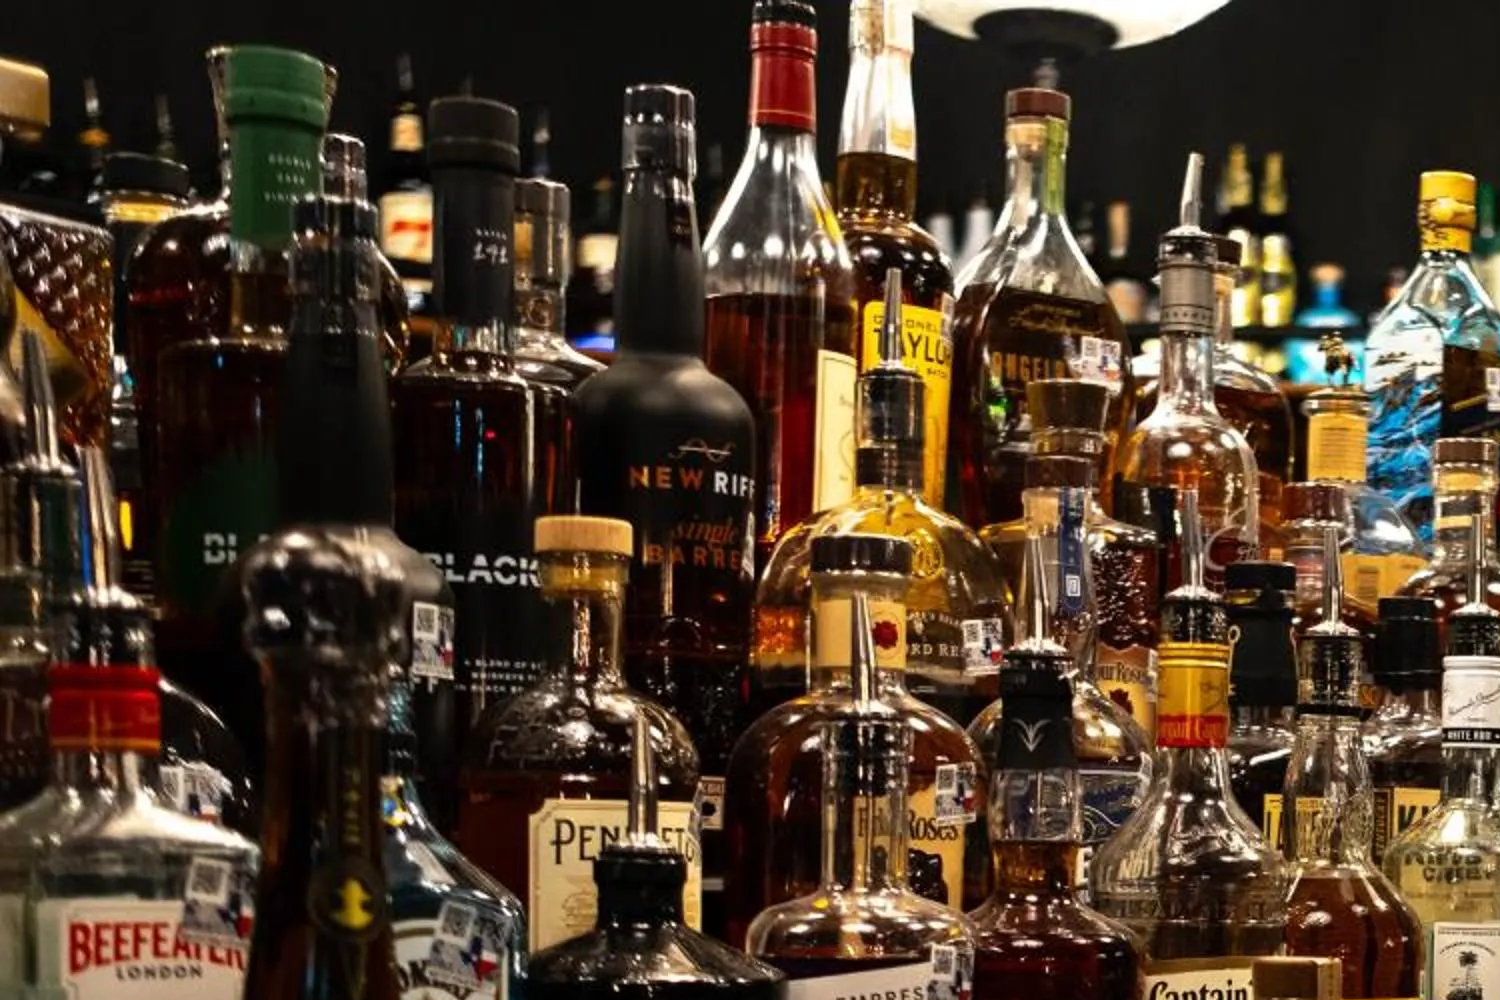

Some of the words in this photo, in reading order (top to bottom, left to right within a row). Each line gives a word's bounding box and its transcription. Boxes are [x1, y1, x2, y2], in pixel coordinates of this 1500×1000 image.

[630, 465, 704, 489] NEW
[644, 543, 741, 571] BARRE
[115, 964, 203, 980] LONDON
